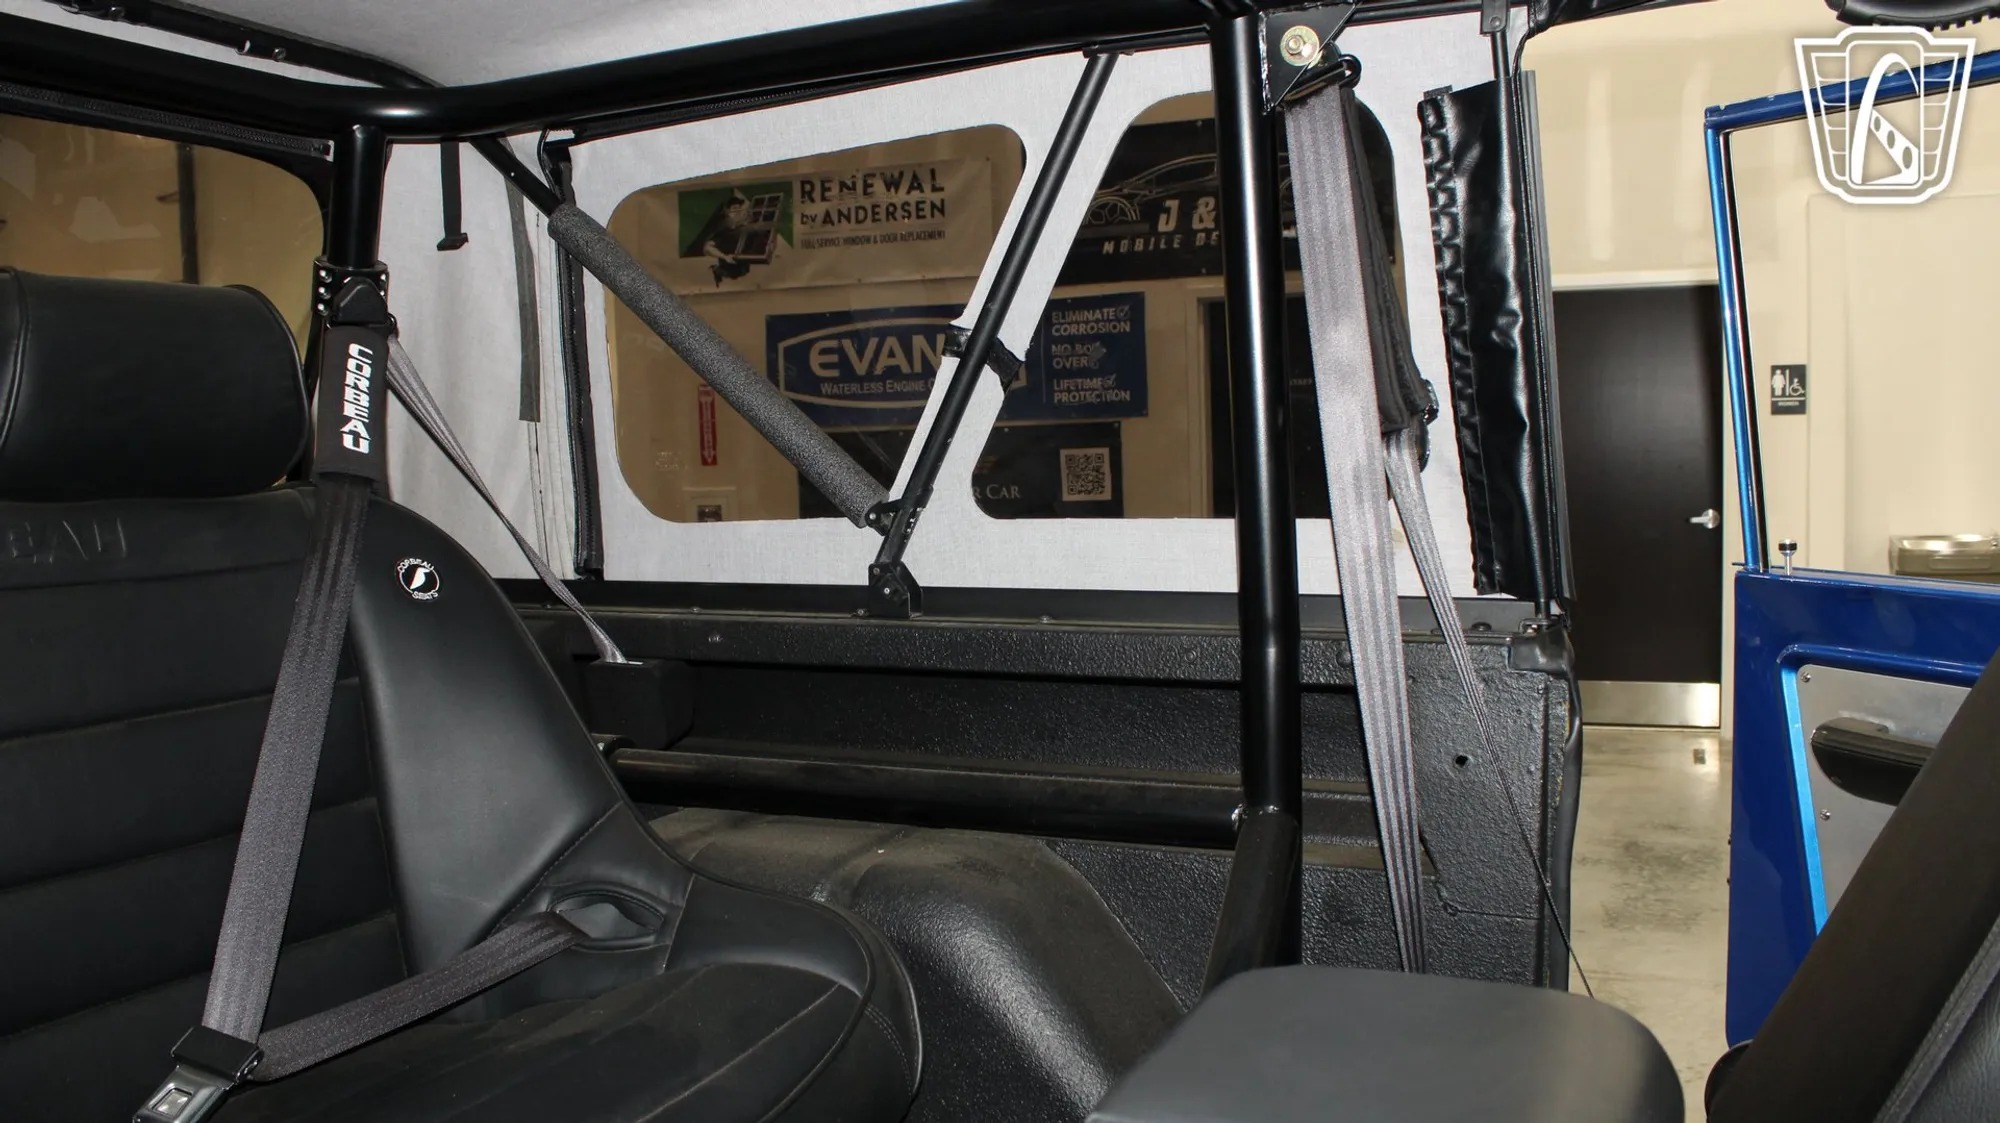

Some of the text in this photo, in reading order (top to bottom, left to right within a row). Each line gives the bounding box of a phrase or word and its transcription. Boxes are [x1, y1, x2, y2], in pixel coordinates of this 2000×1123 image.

[799, 168, 945, 204] RENEWAL
[821, 198, 946, 226] ANDERSEN
[1157, 195, 1217, 233] J &
[1102, 234, 1183, 254] MOBILE
[1051, 307, 1117, 323] ELIMINATE
[1051, 321, 1131, 337] CORROSION
[808, 333, 946, 377] EVAN
[1051, 343, 1072, 356] NO
[1052, 356, 1088, 370] OVER
[1053, 377, 1105, 390] LIFETIME
[339, 343, 374, 455] CORBEAU
[1053, 389, 1131, 403] PROTECTION
[396, 558, 435, 573] CORBEAU
